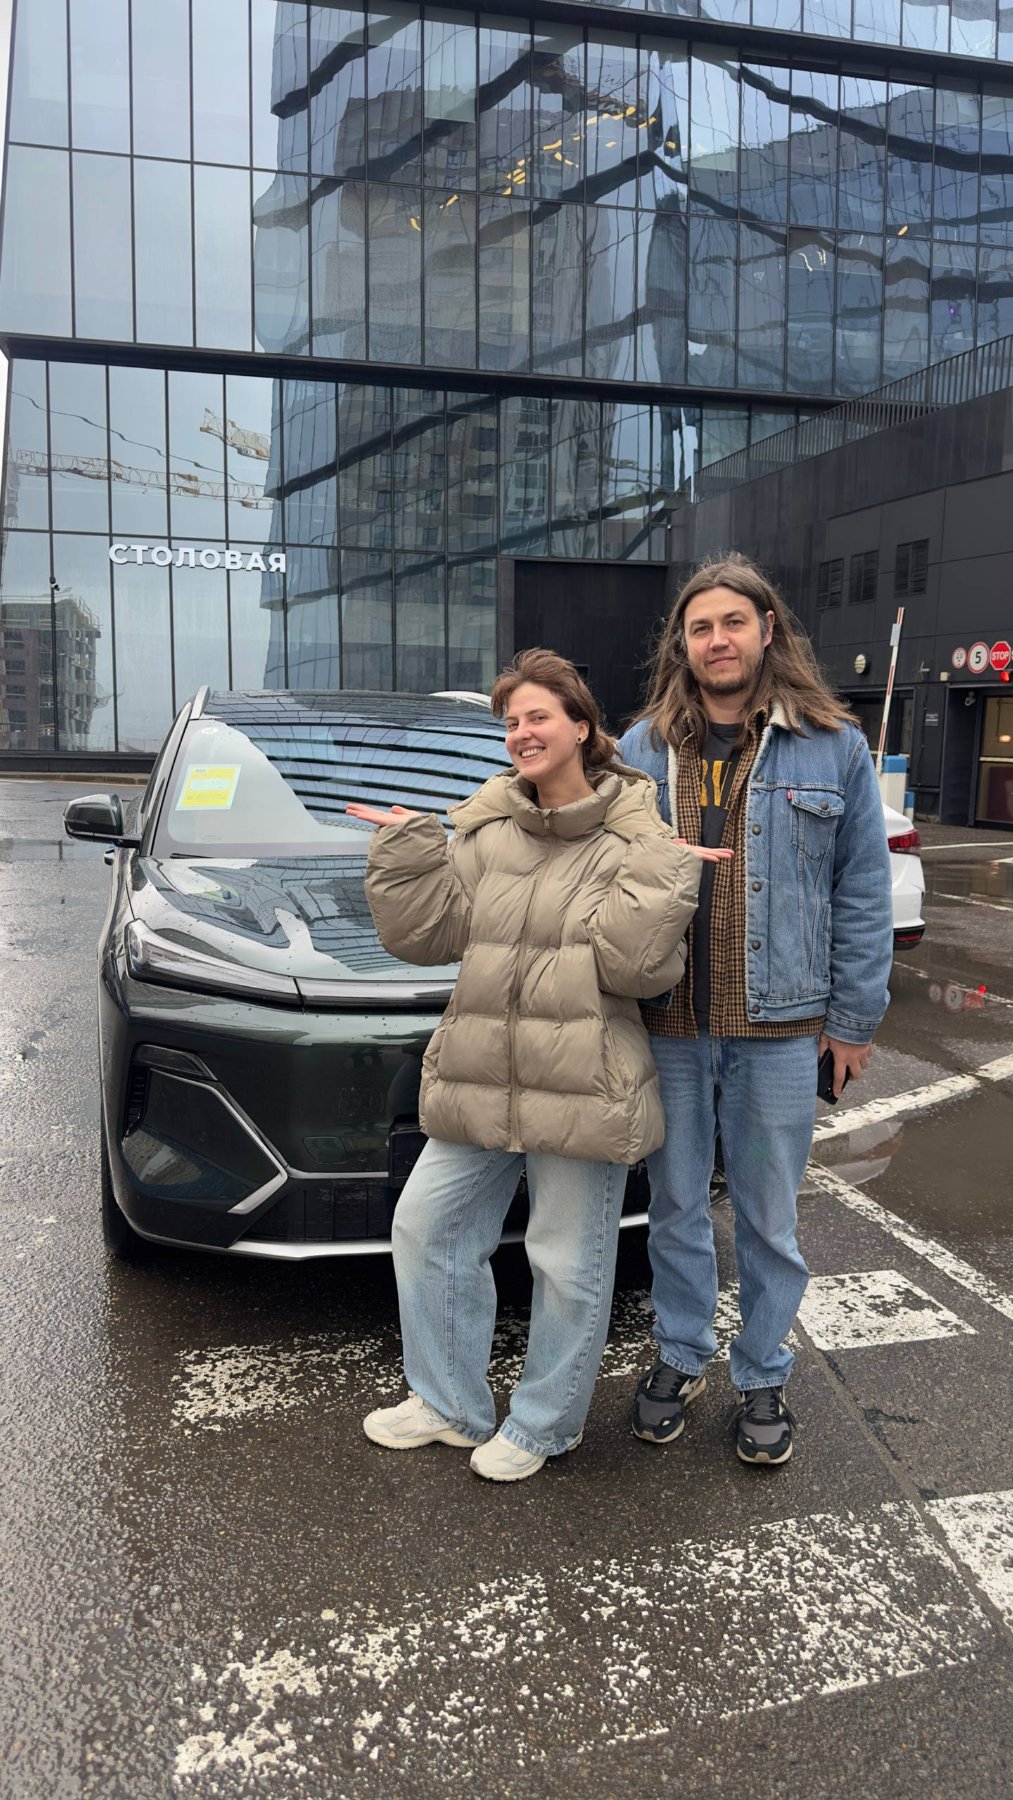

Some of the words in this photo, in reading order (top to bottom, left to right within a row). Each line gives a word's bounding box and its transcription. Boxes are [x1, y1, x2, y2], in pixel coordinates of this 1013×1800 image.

[108, 543, 287, 573] СТОЛОВАЯ
[975, 651, 982, 664] 5
[991, 651, 1009, 661] STOP
